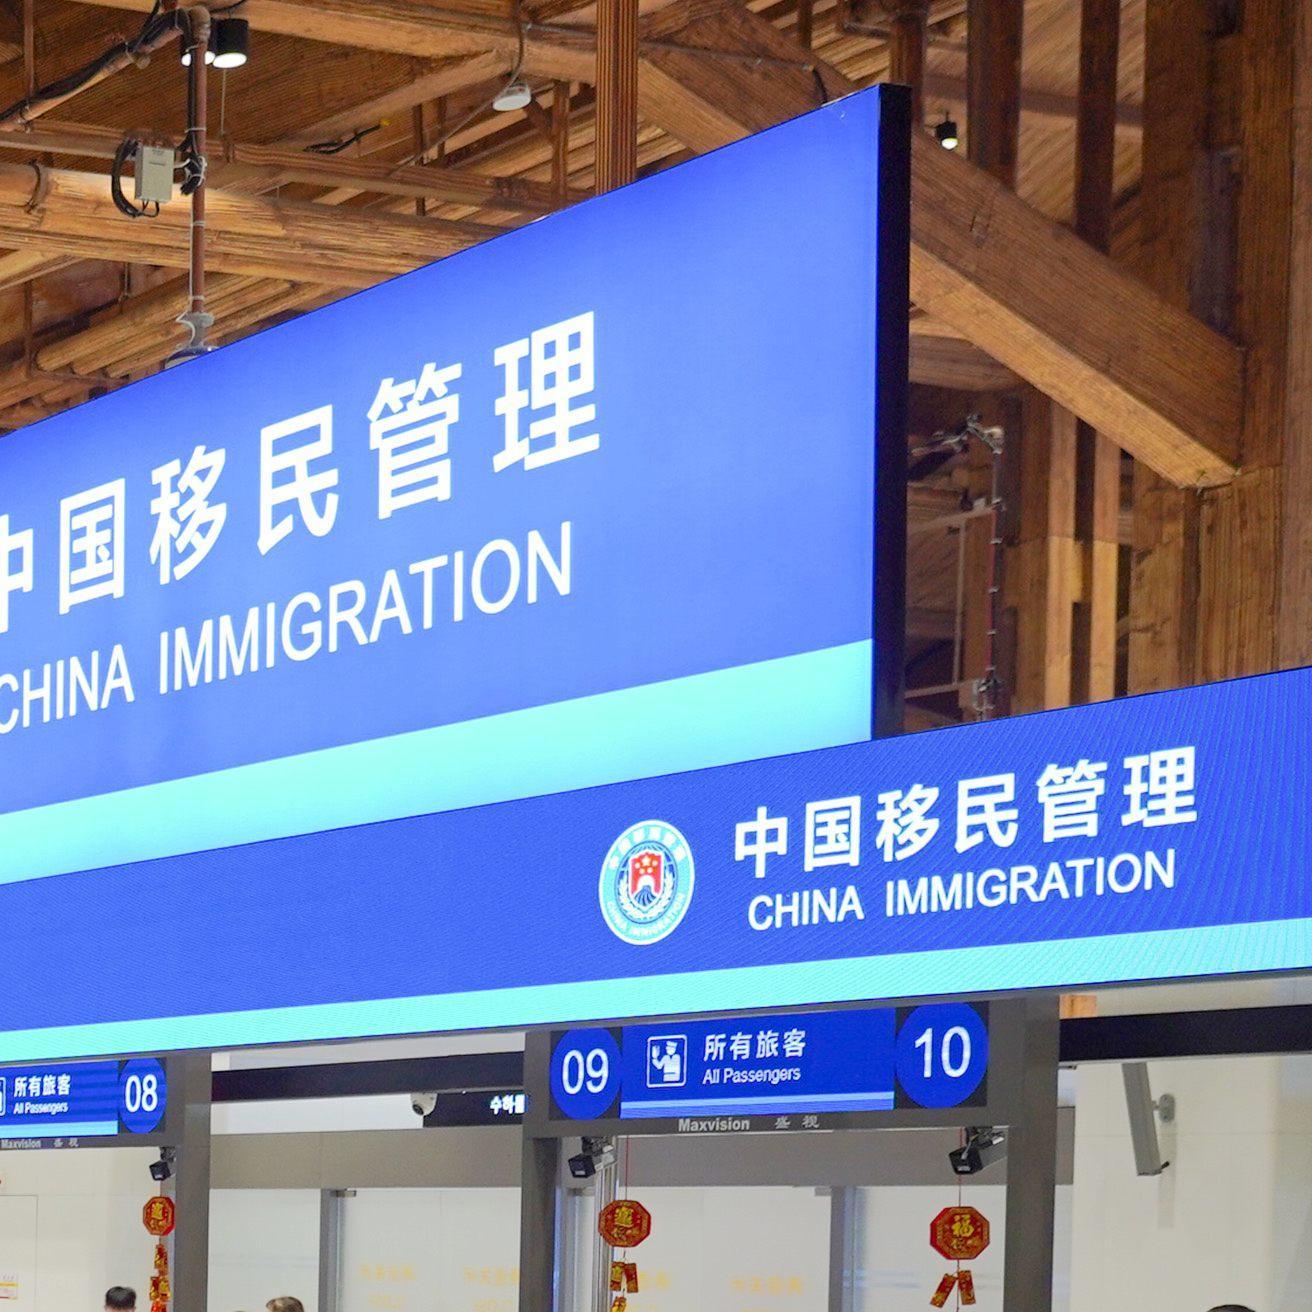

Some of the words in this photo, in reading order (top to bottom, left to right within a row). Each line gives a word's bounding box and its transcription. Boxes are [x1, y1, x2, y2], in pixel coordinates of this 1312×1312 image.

[160, 522, 572, 694] IMMIGRATION
[734, 746, 1198, 879] 中国移民管理
[748, 884, 863, 931] CHINA
[886, 850, 1176, 917] IMMIGRATION
[703, 1028, 806, 1061] 所有旅客
[915, 1026, 971, 1078] 10
[13, 1073, 71, 1098] 所有旅客
[562, 1048, 609, 1095] 09
[702, 1067, 720, 1085] All
[724, 1065, 801, 1087] Passengers
[13, 1102, 23, 1114] All
[25, 1101, 69, 1116] Passengers
[124, 1074, 158, 1113] 08
[678, 1117, 750, 1132] Maxvision
[0, 1138, 41, 1149] Maxvision
